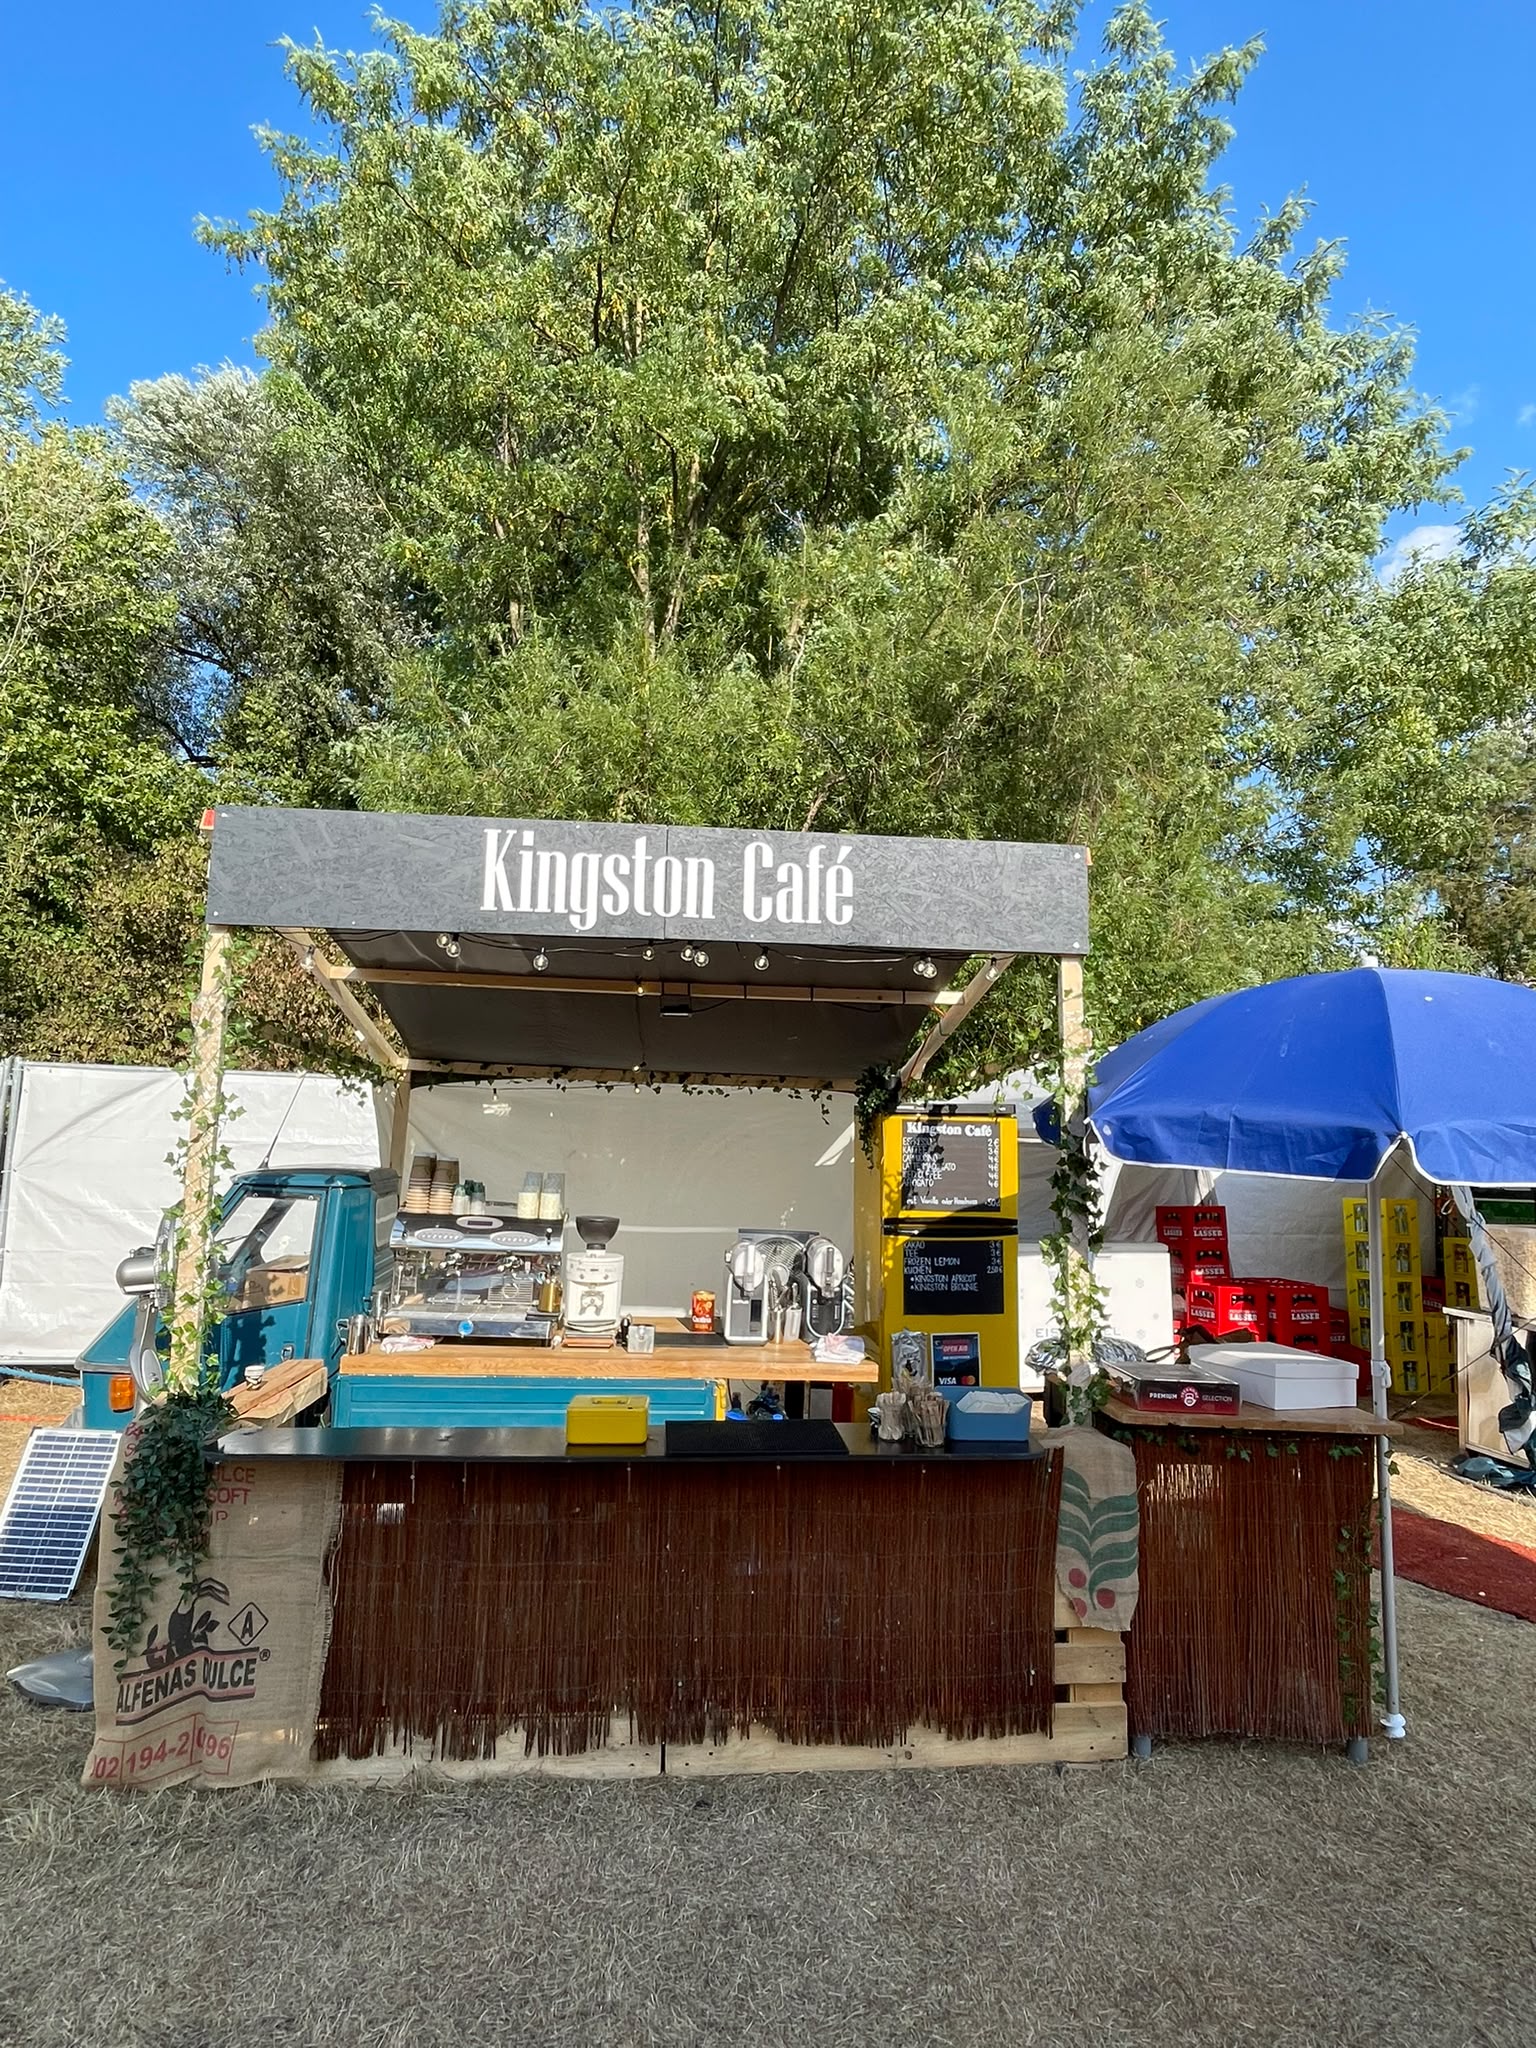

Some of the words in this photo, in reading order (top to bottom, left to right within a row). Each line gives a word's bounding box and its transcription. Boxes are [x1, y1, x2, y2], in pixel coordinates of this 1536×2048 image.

[480, 828, 716, 931] Kingston
[743, 841, 854, 925] Café
[906, 1121, 962, 1136] Kingston
[965, 1124, 993, 1137] Café
[905, 1249, 919, 1258] TEE
[904, 1257, 932, 1266] FROZEN
[934, 1257, 960, 1267] LEMON
[903, 1266, 932, 1275] KUCHEN
[1190, 1307, 1216, 1319] LASSER
[1229, 1312, 1258, 1321] LASSER
[1291, 1312, 1320, 1321] LASSER
[938, 1377, 957, 1385] VISA
[1149, 1392, 1178, 1400] PREMIUM
[1202, 1395, 1233, 1403] SELECTION
[207, 1487, 251, 1505] SOFT
[240, 1610, 254, 1639] A
[116, 1659, 197, 1714] ALFENAS
[202, 1656, 257, 1689] DULCE
[126, 1730, 190, 1773] 194-2
